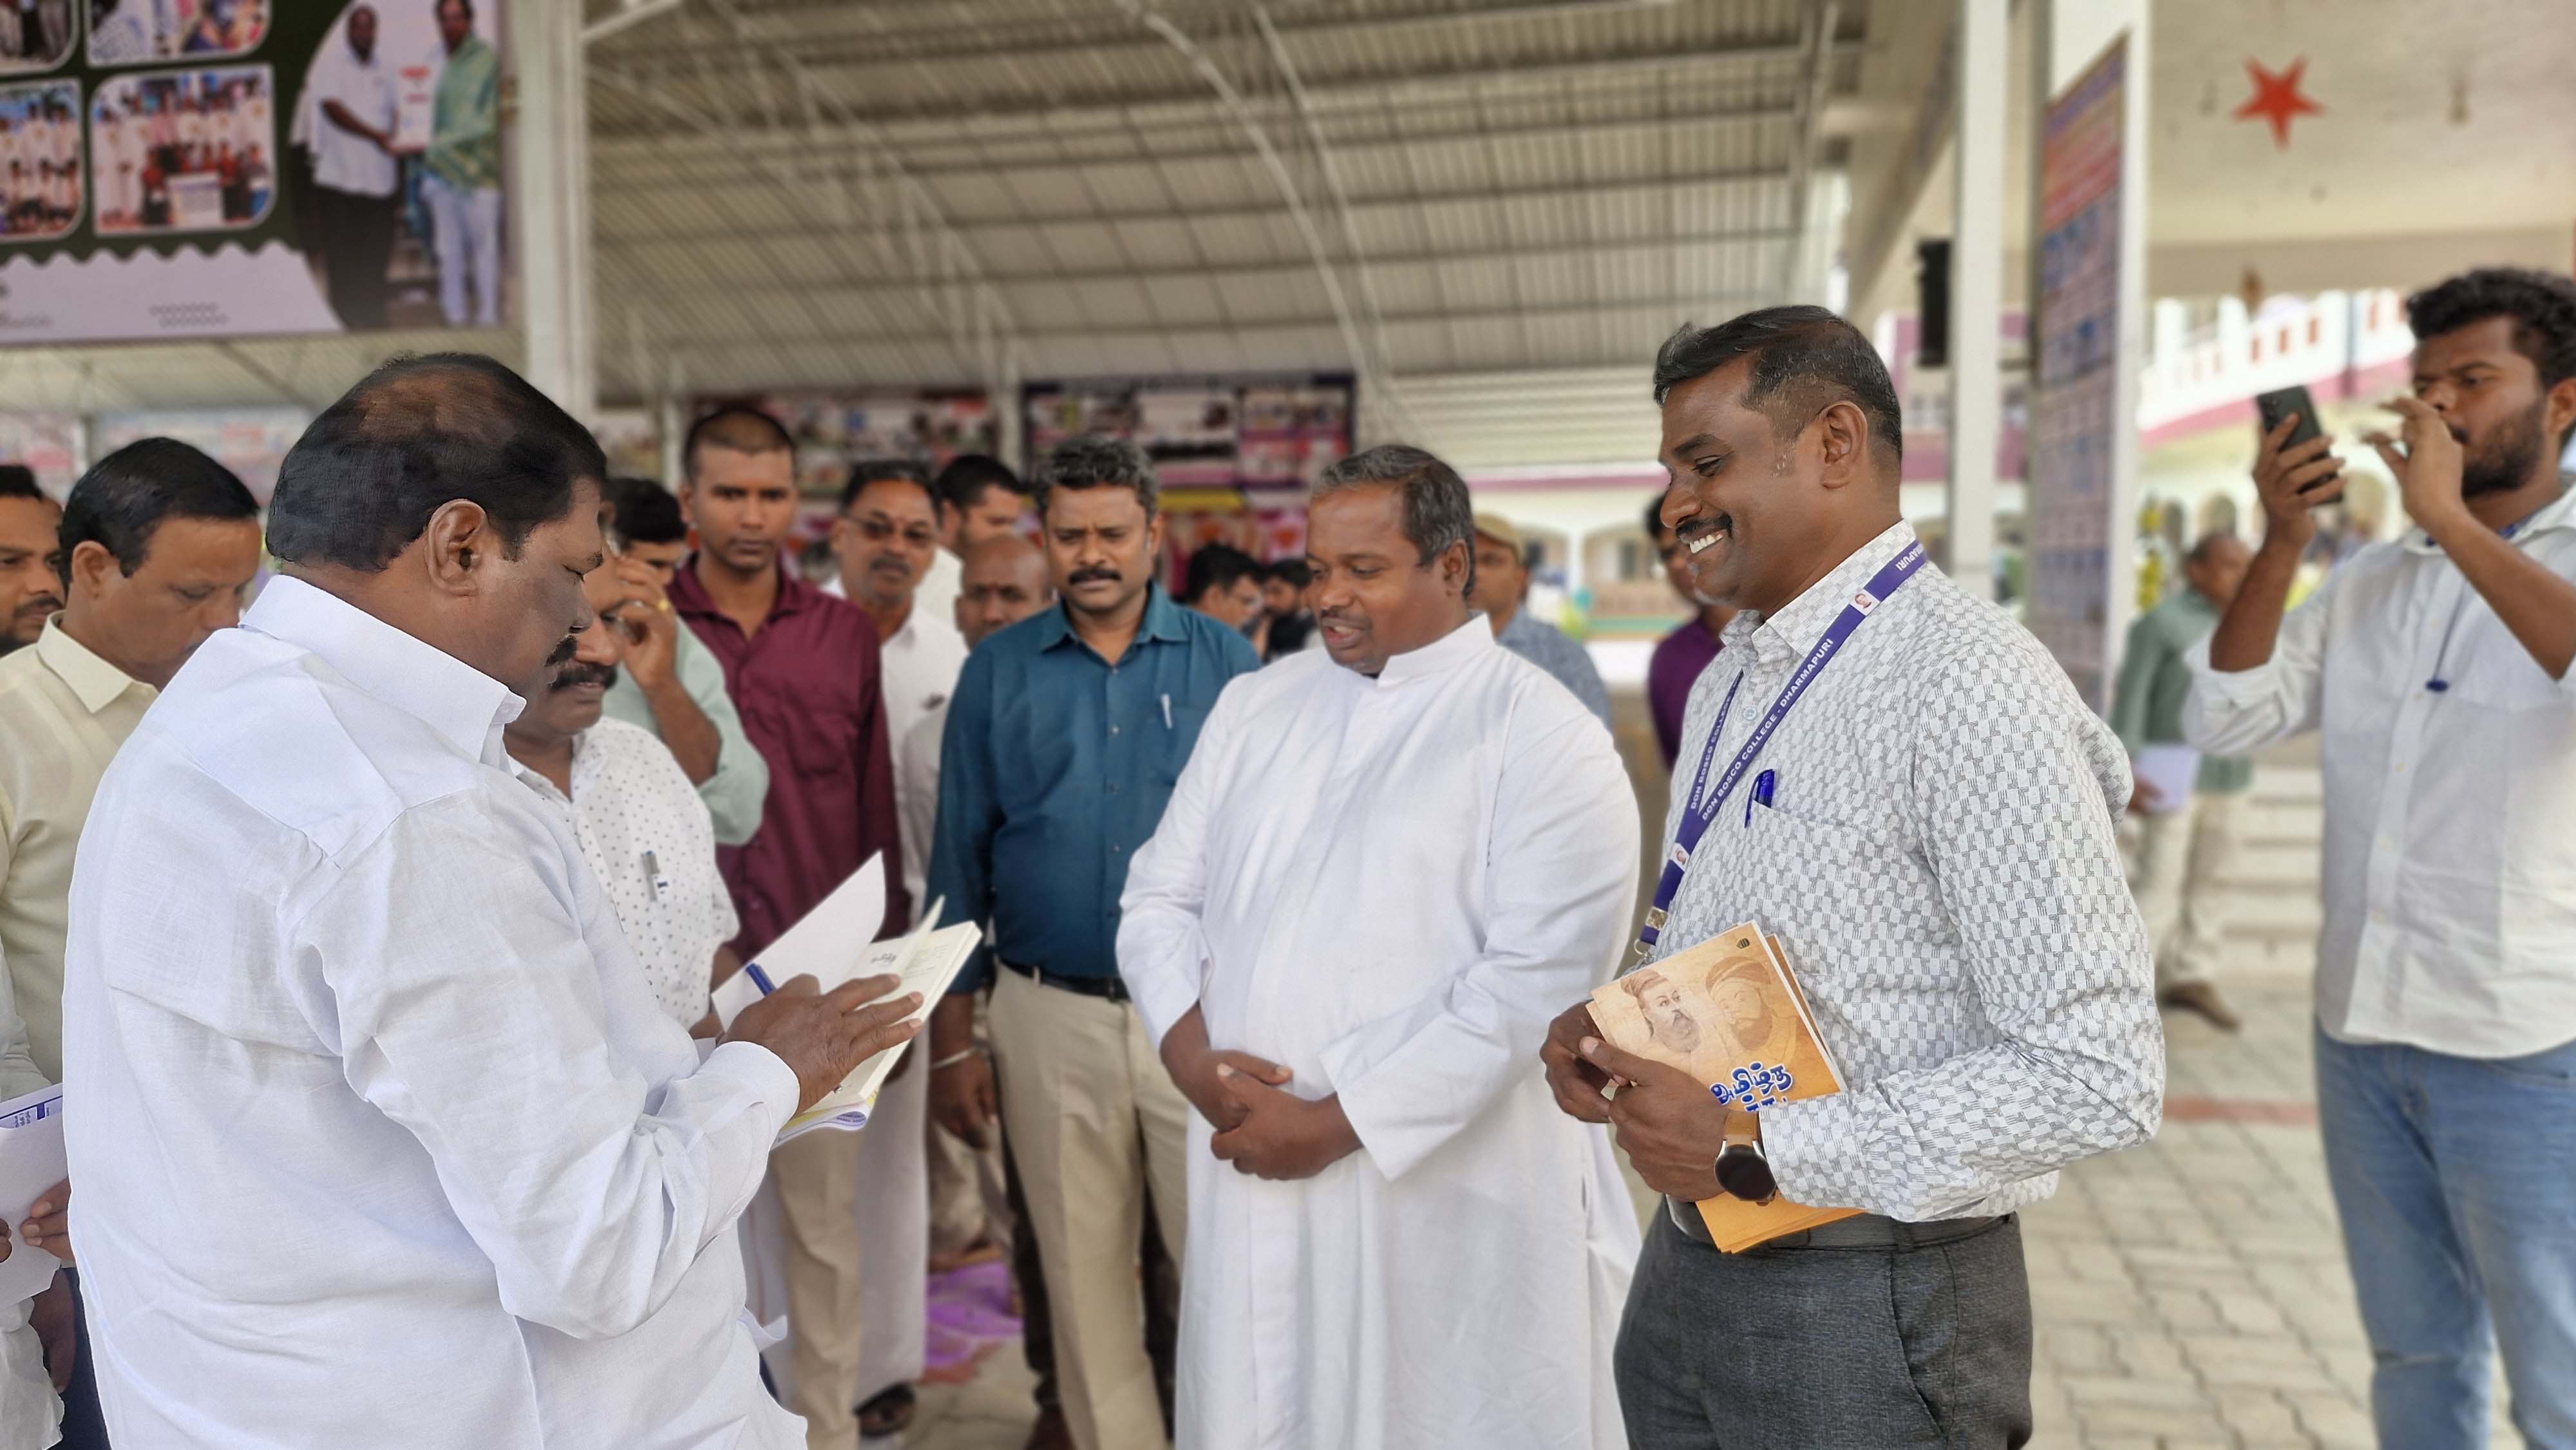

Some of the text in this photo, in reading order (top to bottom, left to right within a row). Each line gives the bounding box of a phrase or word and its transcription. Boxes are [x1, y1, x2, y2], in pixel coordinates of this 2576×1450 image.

[1690, 696, 1731, 809] DON BOSCO COLLEGE
[1702, 798, 1718, 821] DON
[1717, 762, 1741, 797] BOSCO
[1742, 713, 1777, 760] COLLEGE
[1779, 638, 1833, 707] DHARMAPURI
